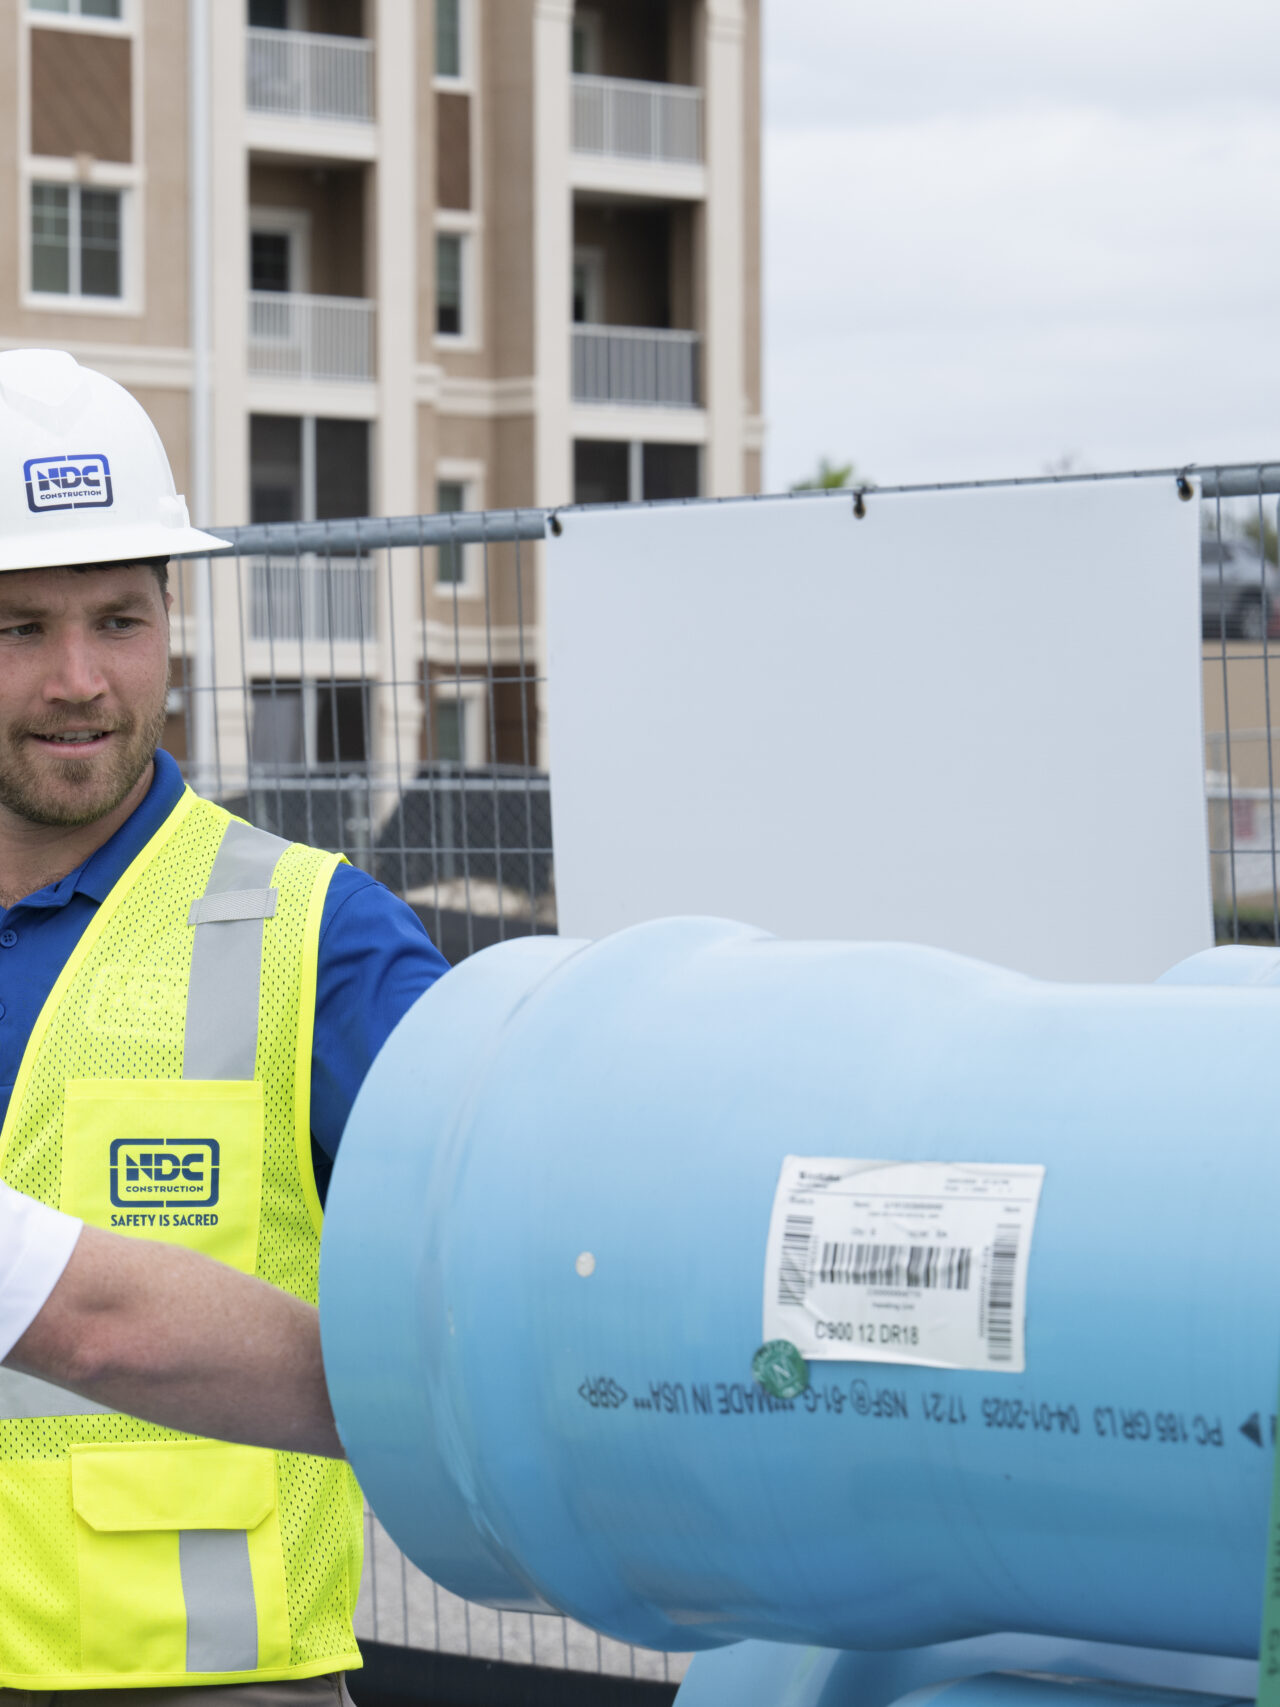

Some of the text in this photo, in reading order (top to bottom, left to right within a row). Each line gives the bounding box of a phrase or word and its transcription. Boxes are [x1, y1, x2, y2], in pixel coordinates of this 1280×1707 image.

[37, 465, 101, 491] NDC
[40, 490, 102, 500] CONSTRUCTION
[126, 1153, 204, 1181] NDC
[126, 1185, 204, 1193] CONSTRUCTION
[111, 1214, 219, 1227] SAFETY IS SACRED
[815, 1320, 920, 1346] C900 12 DR18
[692, 1383, 712, 1415] IN
[981, 1397, 1080, 1435] 04-01-2025
[1094, 1405, 1118, 1438] L3
[1120, 1407, 1151, 1441] GR
[1193, 1413, 1224, 1447] PC
